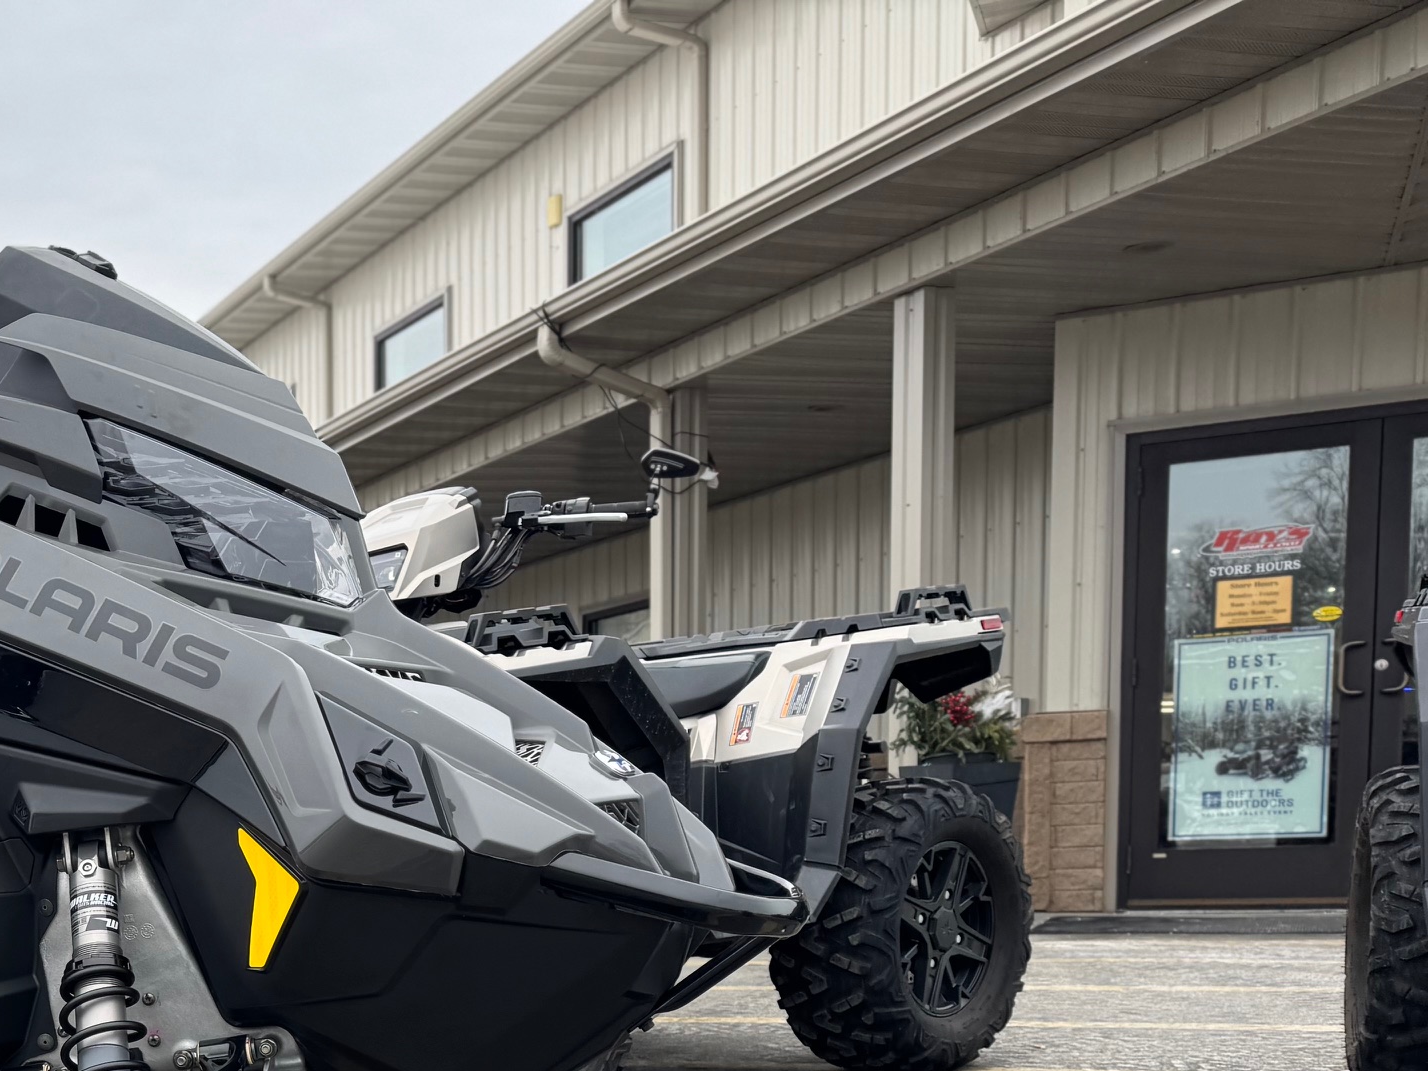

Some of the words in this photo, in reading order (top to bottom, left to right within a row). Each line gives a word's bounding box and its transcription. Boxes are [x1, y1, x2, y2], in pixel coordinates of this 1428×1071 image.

[1209, 564, 1252, 577] STORE
[1256, 560, 1302, 573] HOURS
[1228, 653, 1282, 669] BEST.
[1229, 676, 1279, 690] GIFT.
[1225, 698, 1281, 713] EVER.
[1227, 790, 1254, 798] GIFT
[1259, 789, 1283, 798] THE
